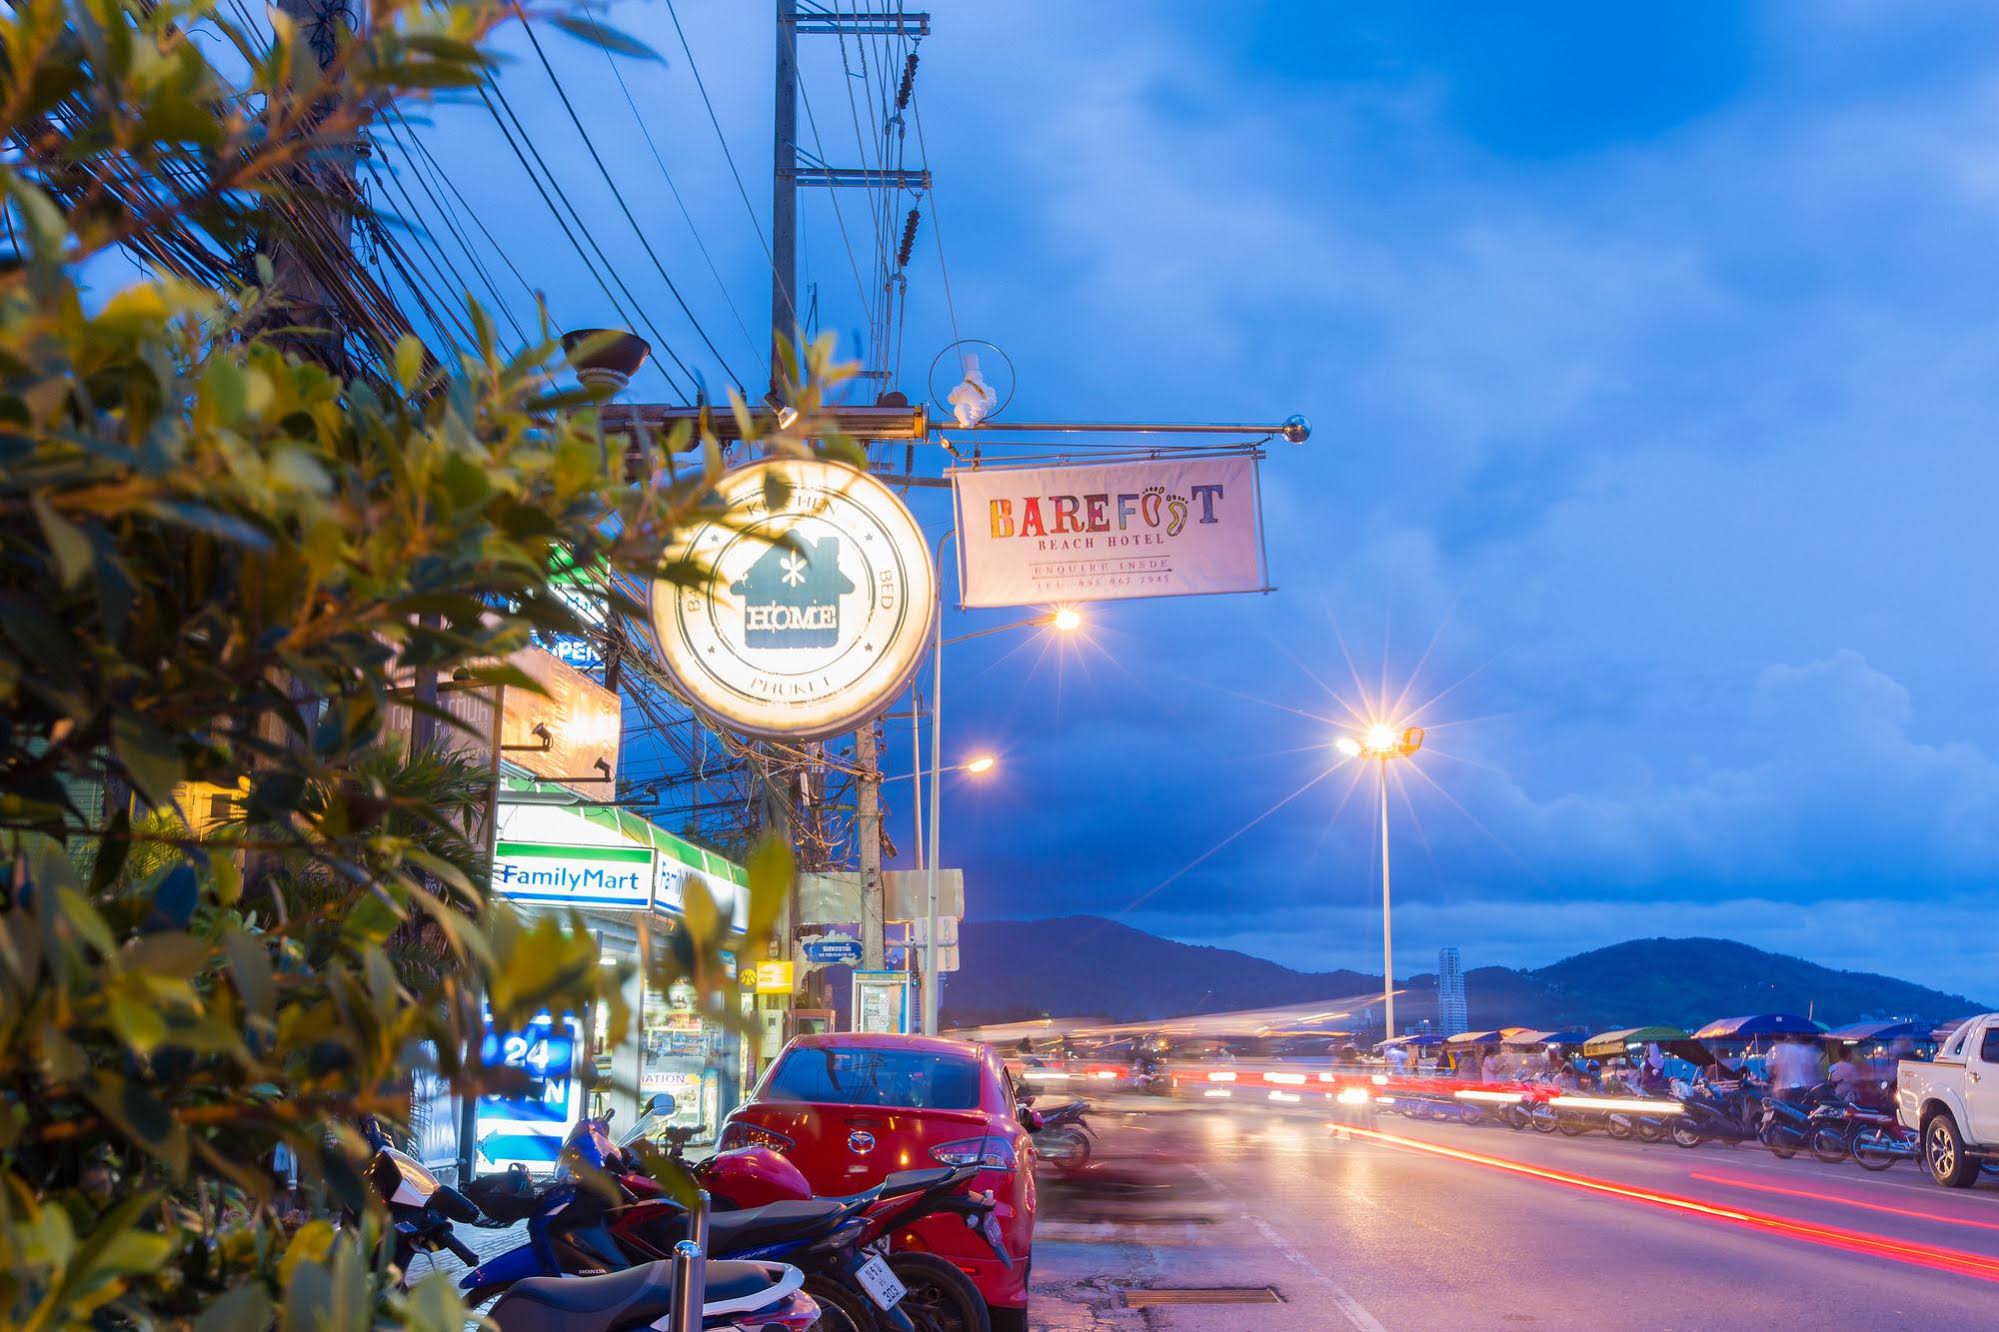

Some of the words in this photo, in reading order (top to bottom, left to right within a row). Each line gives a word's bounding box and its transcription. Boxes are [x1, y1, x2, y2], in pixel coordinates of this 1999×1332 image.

[1038, 538, 1094, 551] BEACH
[1107, 534, 1165, 547] HOTEL
[879, 570, 894, 609] BED
[746, 604, 837, 631] HOME
[502, 864, 640, 892] FamilyMart
[504, 1036, 549, 1069] 24
[882, 1284, 899, 1303] 303
